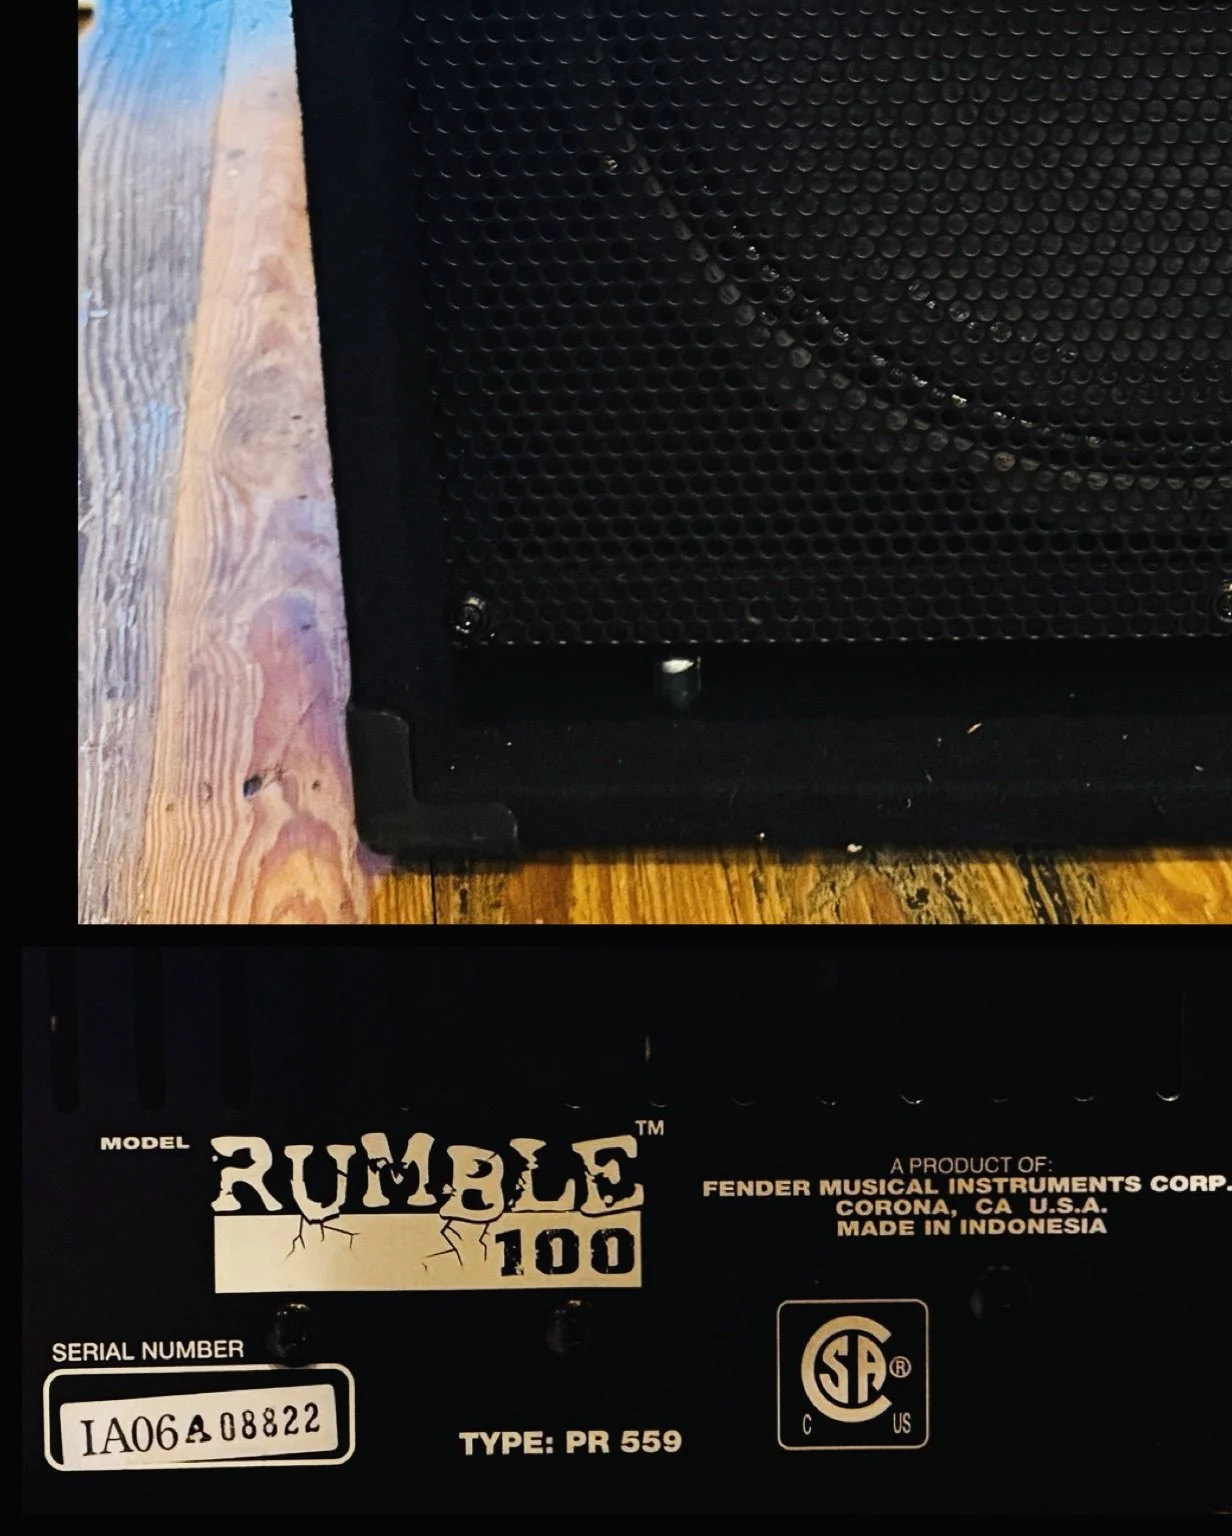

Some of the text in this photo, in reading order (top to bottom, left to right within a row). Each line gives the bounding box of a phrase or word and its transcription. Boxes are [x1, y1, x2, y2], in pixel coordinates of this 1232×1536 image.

[101, 1135, 190, 1150] MODEL
[890, 1156, 1053, 1175] A PRODUCT OF:
[211, 1132, 644, 1224] RUMBLE
[703, 1179, 811, 1197] FENDER
[819, 1178, 938, 1196] MUSICAL
[948, 1176, 1142, 1195] INSTRUMENTS
[835, 1197, 1108, 1218] CORONA, CA U.S.A.
[837, 1218, 1108, 1237] MADE IN INDONESIA
[495, 1227, 636, 1276] 100
[52, 1339, 243, 1362] SERIAL NUMBER
[802, 1414, 812, 1435] C
[893, 1412, 911, 1435] US
[459, 1431, 682, 1455] TYPE: PR 559
